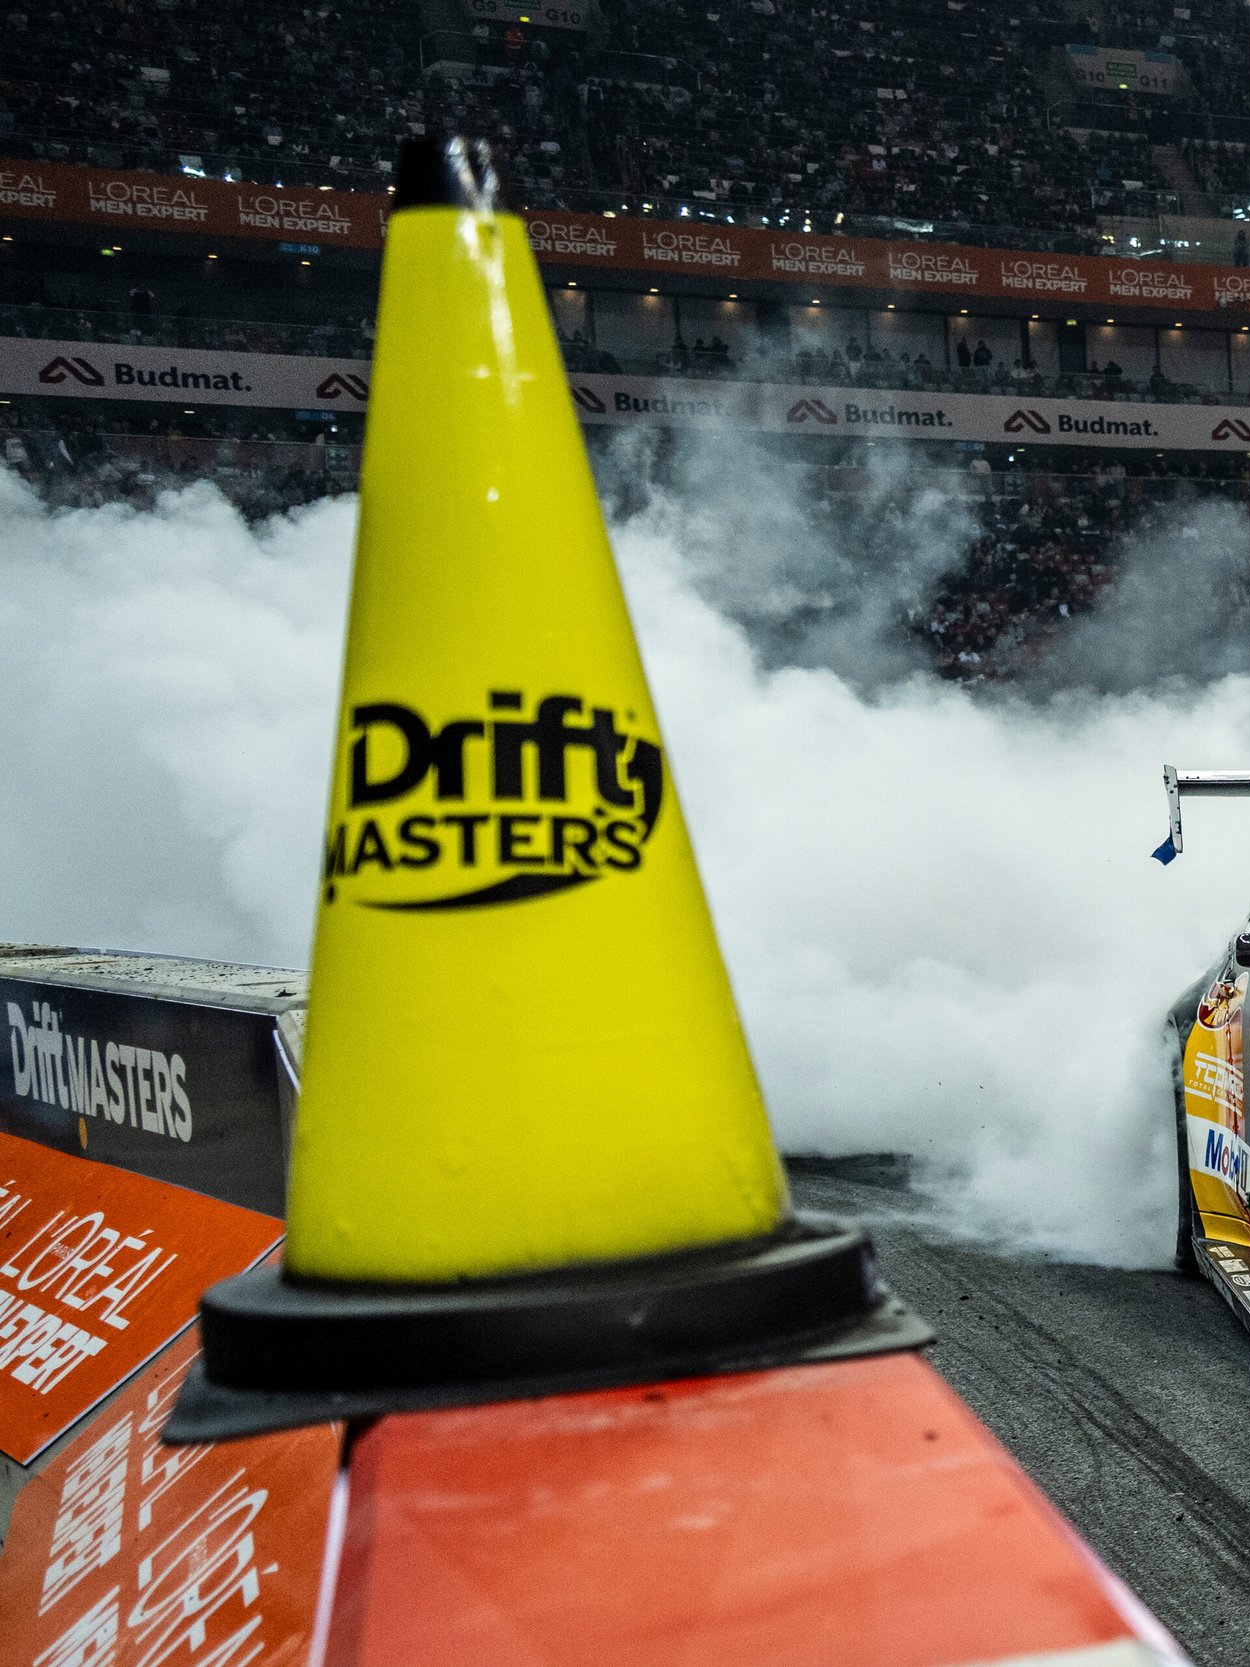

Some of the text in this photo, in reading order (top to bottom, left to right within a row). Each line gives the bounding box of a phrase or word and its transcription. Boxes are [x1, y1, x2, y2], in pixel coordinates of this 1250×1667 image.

[90, 199, 208, 221] MEN EXPERT
[240, 213, 351, 236] MEN EXPERT
[644, 248, 740, 267] MEN EXPERT
[772, 259, 865, 277] MEN EXPERT
[889, 267, 978, 285] MEN EXPERT
[1002, 276, 1088, 294] MEN EXPERT
[1110, 285, 1193, 301] MEN EXPERT
[114, 364, 252, 392] Budmat.
[844, 404, 953, 427] Budmat.
[1058, 415, 1158, 437] Budmat.
[351, 691, 637, 808] Drift
[65, 1033, 192, 1143] MASTERS
[0, 1210, 179, 1331] L'ORÉAL
